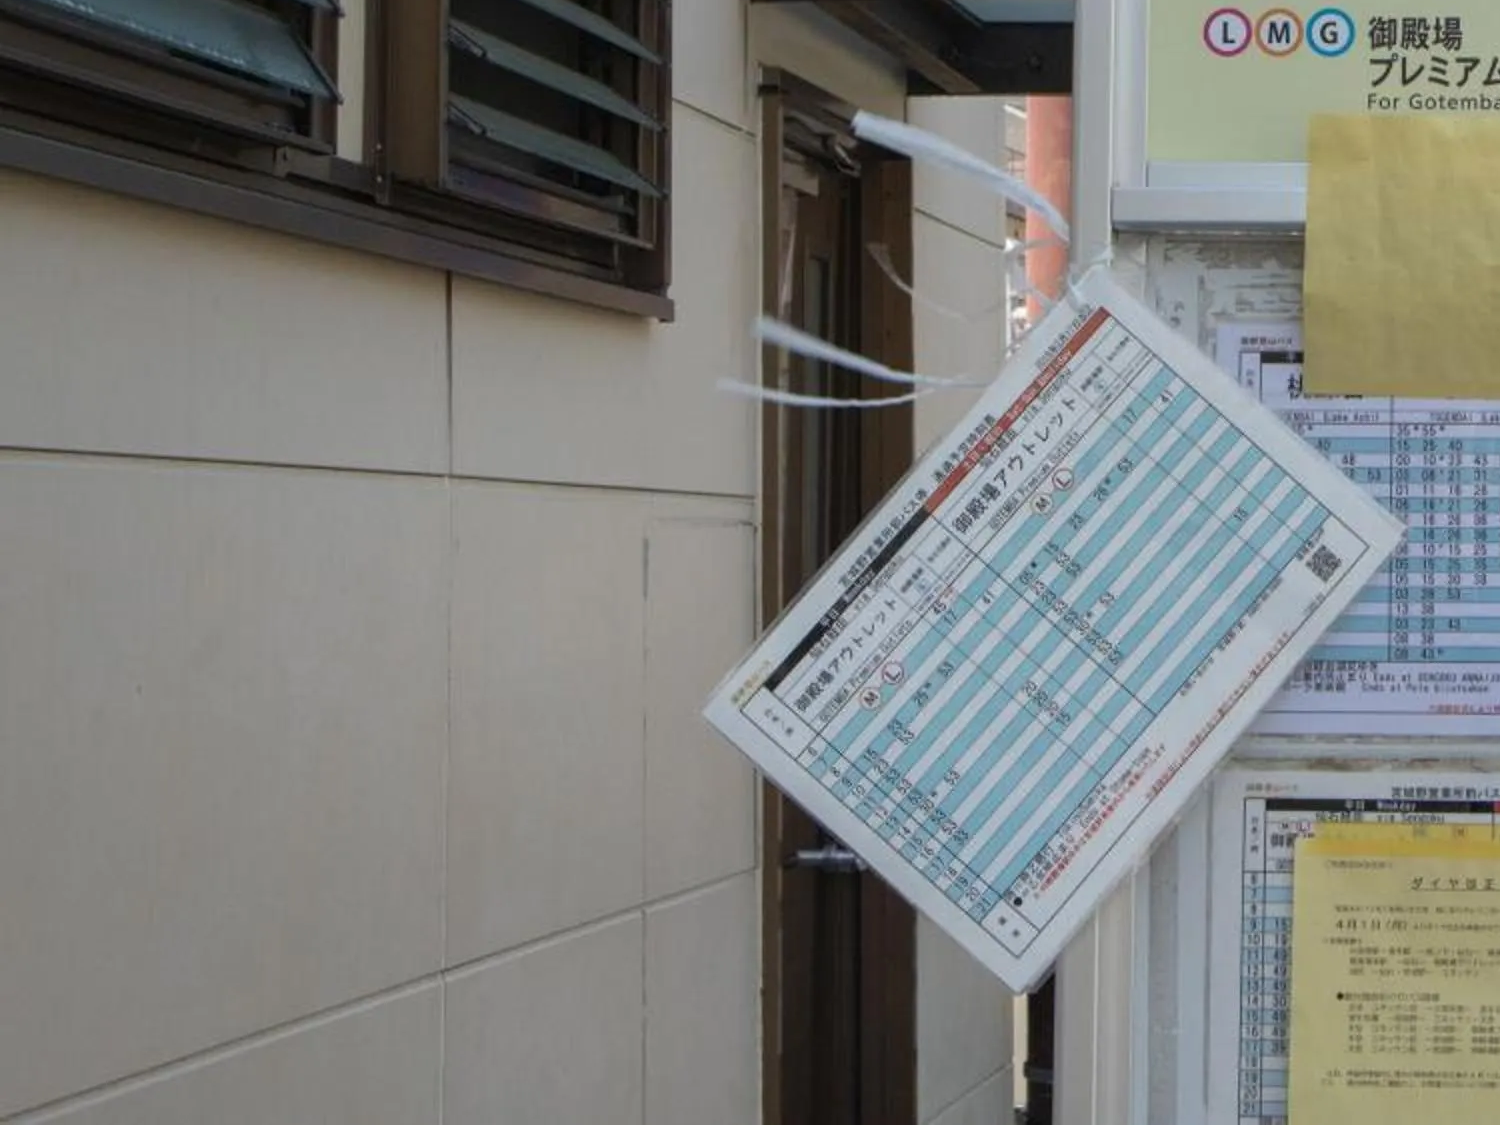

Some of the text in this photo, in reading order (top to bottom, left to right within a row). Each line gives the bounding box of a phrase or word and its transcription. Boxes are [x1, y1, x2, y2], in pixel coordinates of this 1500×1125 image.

[1368, 17, 1464, 52] 御殿場
[1367, 94, 1399, 110] For
